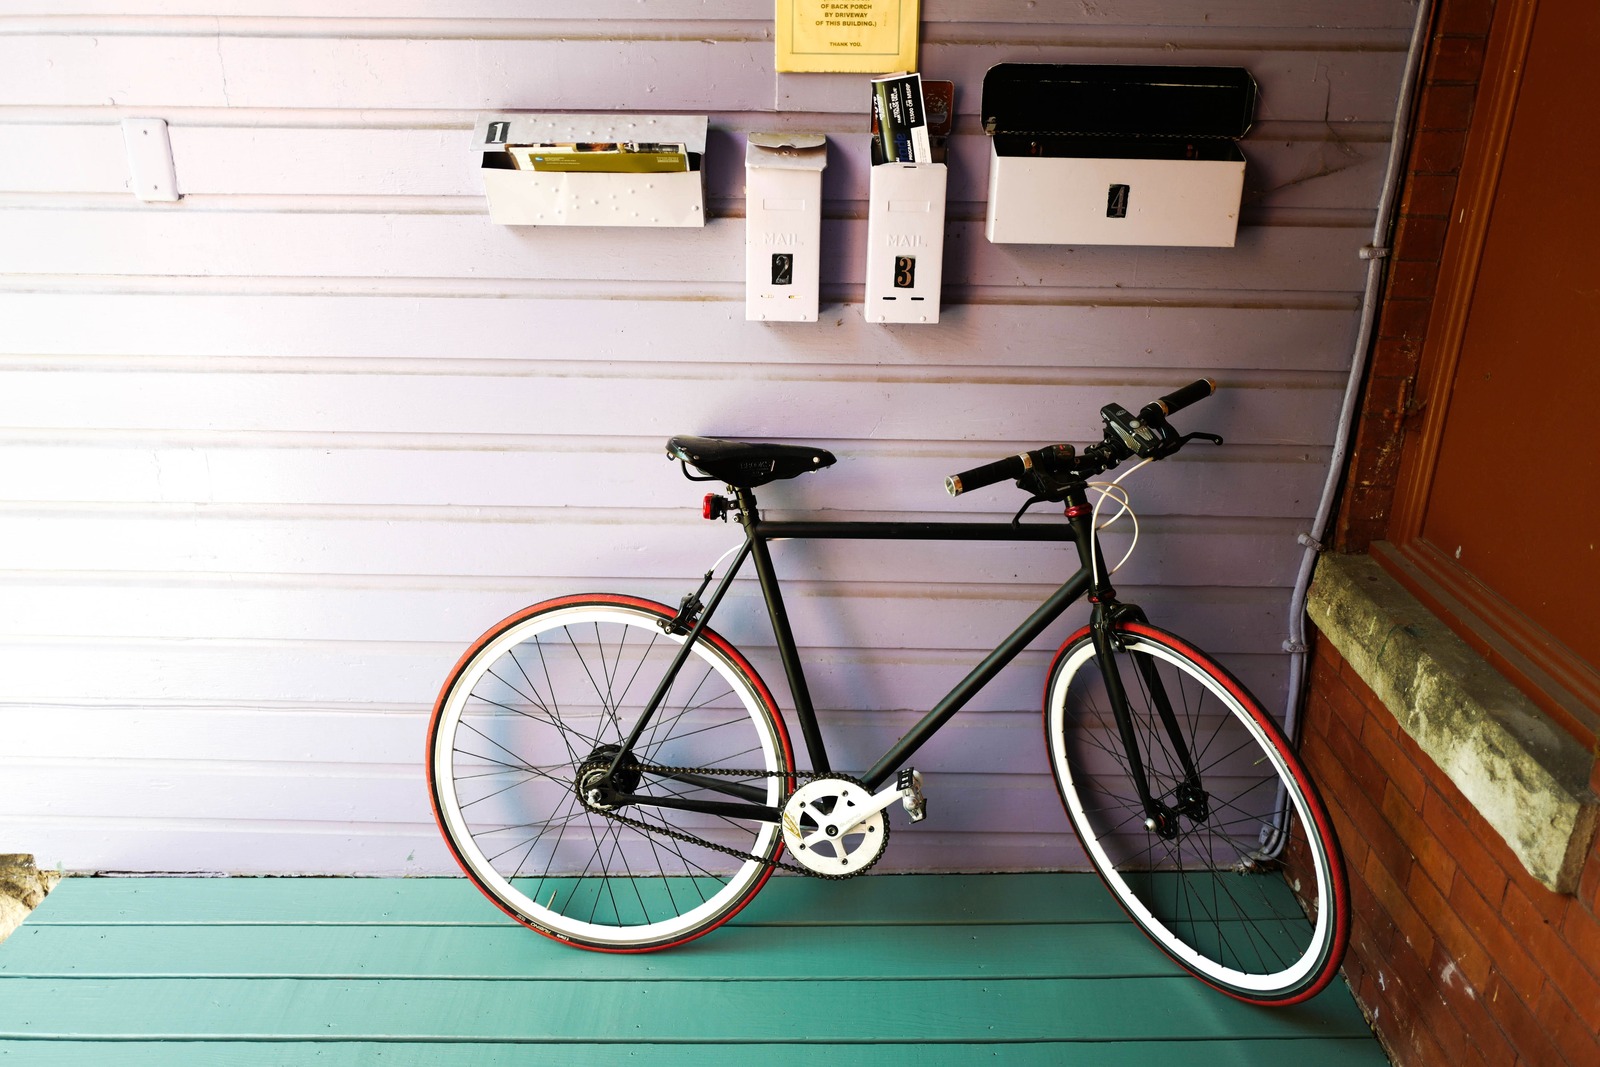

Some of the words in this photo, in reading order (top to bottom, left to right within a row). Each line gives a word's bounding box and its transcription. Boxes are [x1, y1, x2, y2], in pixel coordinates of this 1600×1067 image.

[490, 122, 504, 143] 1
[1110, 186, 1126, 217] 4
[762, 232, 804, 246] MAIL
[886, 234, 928, 247] MAIL
[775, 255, 790, 284] 2
[897, 257, 912, 287] 3
